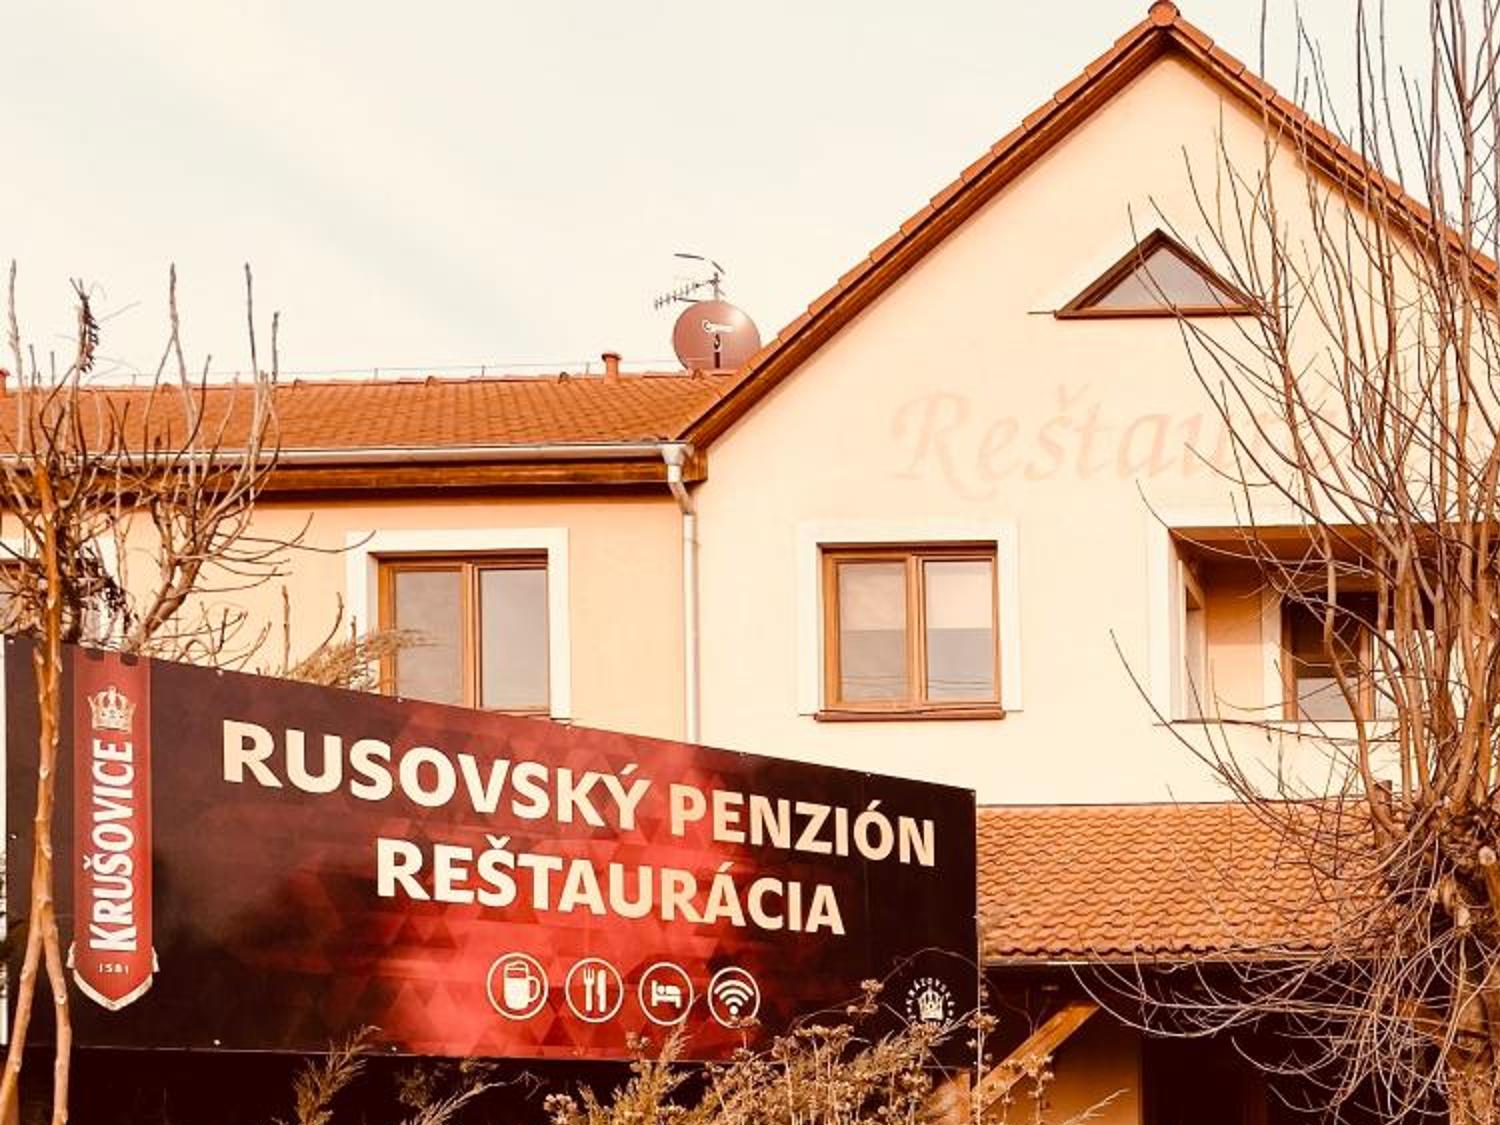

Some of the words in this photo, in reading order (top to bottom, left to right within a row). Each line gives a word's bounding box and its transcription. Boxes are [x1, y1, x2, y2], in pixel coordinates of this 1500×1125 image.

[83, 738, 137, 953] KRUŠOVICE
[221, 718, 653, 832] RUSOVSKÝ
[669, 783, 936, 869] PENZIÓN
[375, 836, 847, 935] REŠTAURÁCIA
[97, 963, 130, 975] 1581
